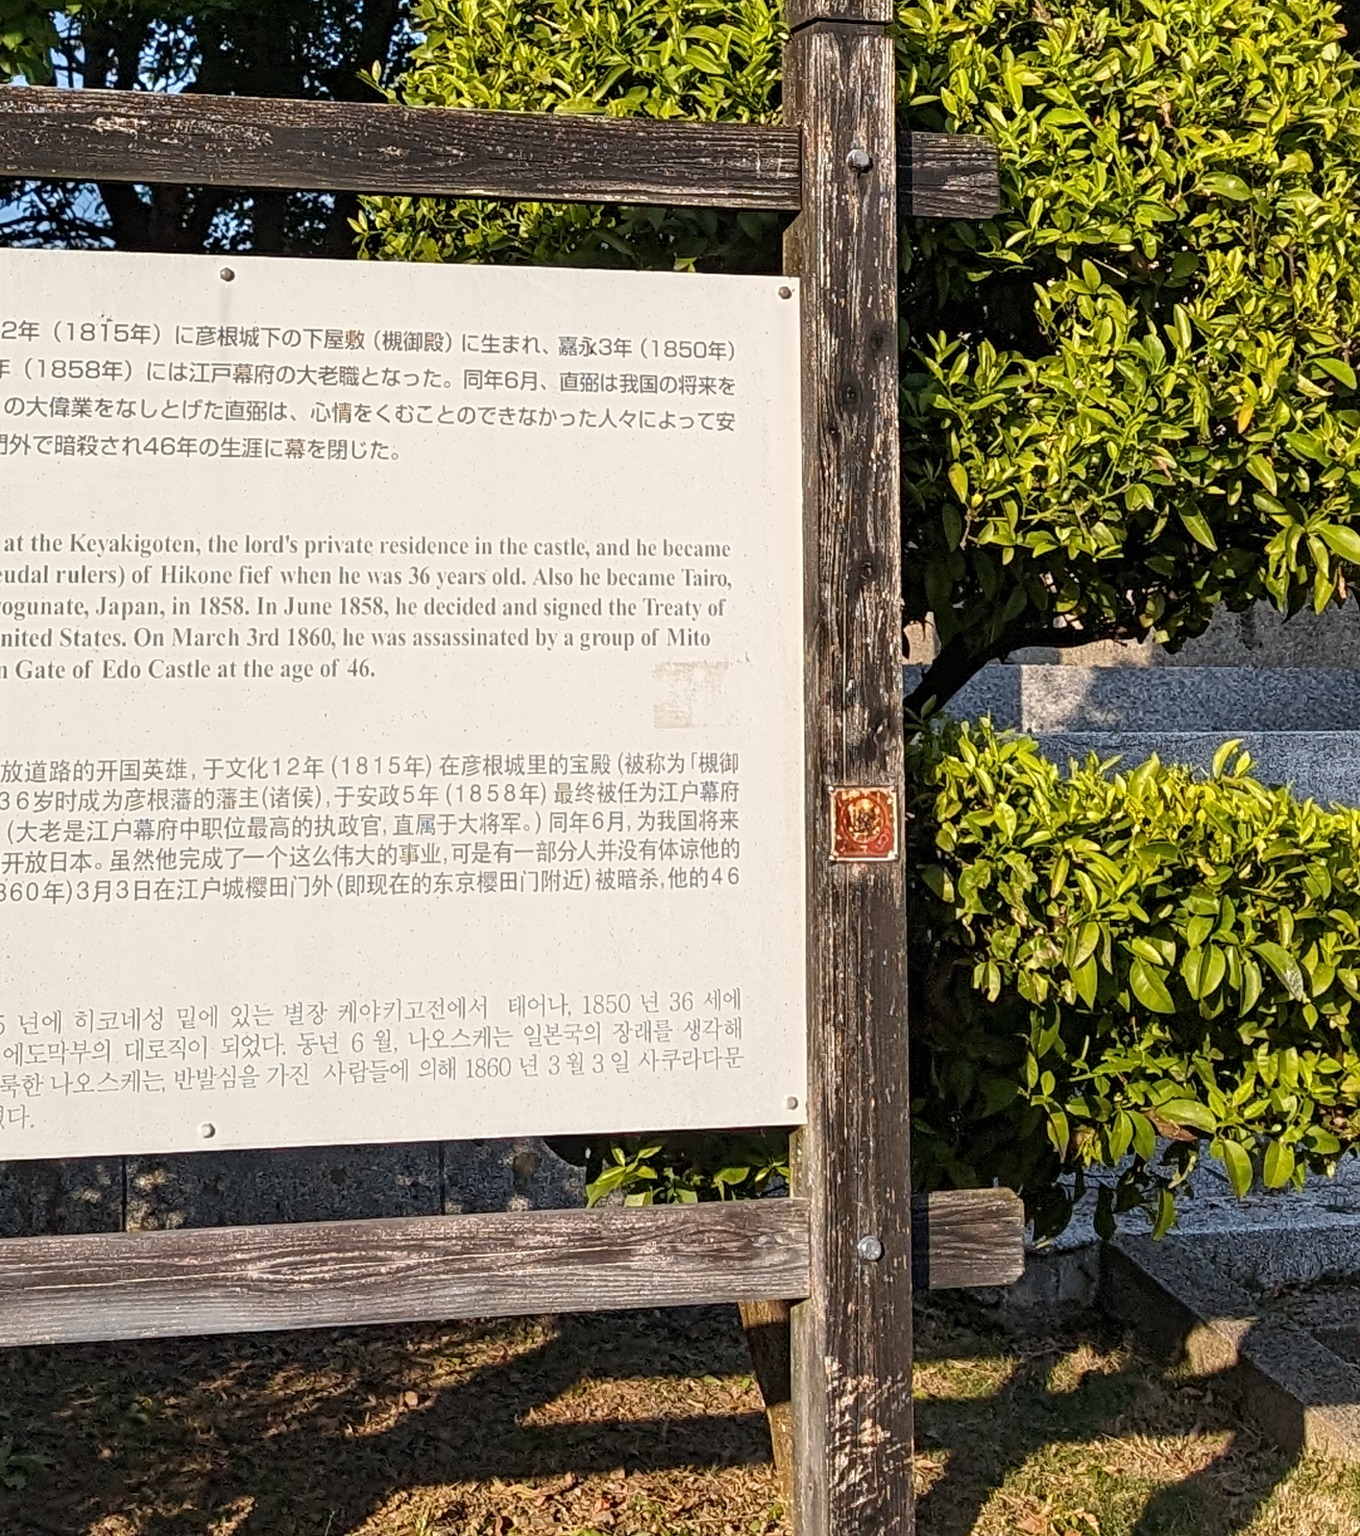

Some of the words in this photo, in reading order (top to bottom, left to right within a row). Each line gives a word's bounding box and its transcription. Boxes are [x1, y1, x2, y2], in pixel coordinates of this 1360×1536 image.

[2, 533, 25, 553] at
[29, 531, 64, 553] the
[68, 532, 202, 560] Keyakigoten,
[206, 533, 240, 554] the
[243, 533, 299, 555] lord's
[303, 533, 375, 560] private
[378, 534, 470, 556] residence
[473, 534, 493, 556] in
[498, 535, 529, 557] the
[532, 536, 591, 561] castle,
[594, 537, 631, 557] and
[635, 537, 658, 558] he
[661, 537, 732, 558] became
[54, 563, 126, 590] rulers)
[130, 563, 154, 585] of
[159, 563, 234, 586] Hikone
[237, 563, 274, 585] fief
[278, 564, 333, 586] when
[337, 564, 362, 586] he
[365, 569, 403, 586] was
[406, 564, 432, 586] 36
[434, 569, 487, 591] years
[490, 565, 527, 587] old.
[530, 565, 575, 587] Also
[578, 566, 602, 587] he
[605, 566, 677, 588] became
[679, 567, 733, 592] Tairo,
[94, 594, 167, 622] Japan,
[170, 594, 192, 616] in
[199, 594, 251, 617] 1858.
[255, 595, 278, 616] In
[282, 594, 334, 617] June
[339, 594, 390, 621] 1858,
[394, 595, 419, 617] he
[422, 595, 497, 617] decided
[500, 595, 539, 617] and
[542, 595, 603, 623] signed
[607, 596, 638, 617] the
[640, 596, 703, 623] Treaty
[706, 596, 728, 618] of
[58, 626, 128, 654] States.
[132, 626, 165, 648] On
[170, 626, 241, 648] March
[245, 626, 280, 648] 3rd
[286, 625, 338, 651] 1860,
[341, 626, 366, 647] he
[369, 631, 407, 647] was
[411, 626, 530, 647] assassinated
[534, 626, 559, 653] by
[562, 631, 575, 647] a
[578, 631, 636, 653] group
[639, 626, 661, 647] of
[665, 626, 712, 647] Mito
[13, 658, 67, 681] Gate
[71, 657, 95, 680] of
[100, 657, 142, 680] Edo
[146, 657, 212, 680] Castle
[215, 659, 238, 679] at
[242, 657, 275, 679] the
[278, 662, 315, 684] age
[318, 656, 342, 679] of
[345, 656, 376, 679] 46.
[16, 1008, 63, 1036] 년에
[71, 1004, 164, 1035] 히코네성
[175, 1003, 219, 1031] 밑에
[229, 1002, 275, 1030] 있는
[282, 999, 329, 1027] 별장
[336, 993, 488, 1025] 케야키고전에서
[506, 990, 573, 1020] 태어나,
[581, 991, 632, 1016] 1850
[638, 988, 660, 1015] 년
[668, 989, 694, 1013] 36
[701, 985, 742, 1013] 세에
[1, 1035, 112, 1069] 에도막부의
[123, 1033, 208, 1064] 대로직이
[218, 1030, 287, 1060] 되었다.
[295, 1029, 340, 1057] 동년
[350, 1030, 365, 1054] 6
[370, 1027, 399, 1055] 월,
[406, 1023, 515, 1053] 나오스케는
[522, 1019, 602, 1049] 일본국의
[610, 1017, 674, 1046] 장래를
[681, 1014, 743, 1043] 생각해
[48, 1067, 166, 1098] 나오스케는,
[172, 1062, 261, 1093] 반발심을
[265, 1060, 311, 1089] 가진
[321, 1056, 409, 1086] 사람들에
[416, 1054, 457, 1083] 의해
[463, 1055, 513, 1080] 1860
[517, 1052, 540, 1078] 년
[546, 1053, 561, 1077] 3
[564, 1048, 586, 1077] 월
[590, 1051, 606, 1075] 3
[609, 1048, 631, 1075] 일
[636, 1044, 746, 1074] 사쿠라다문
